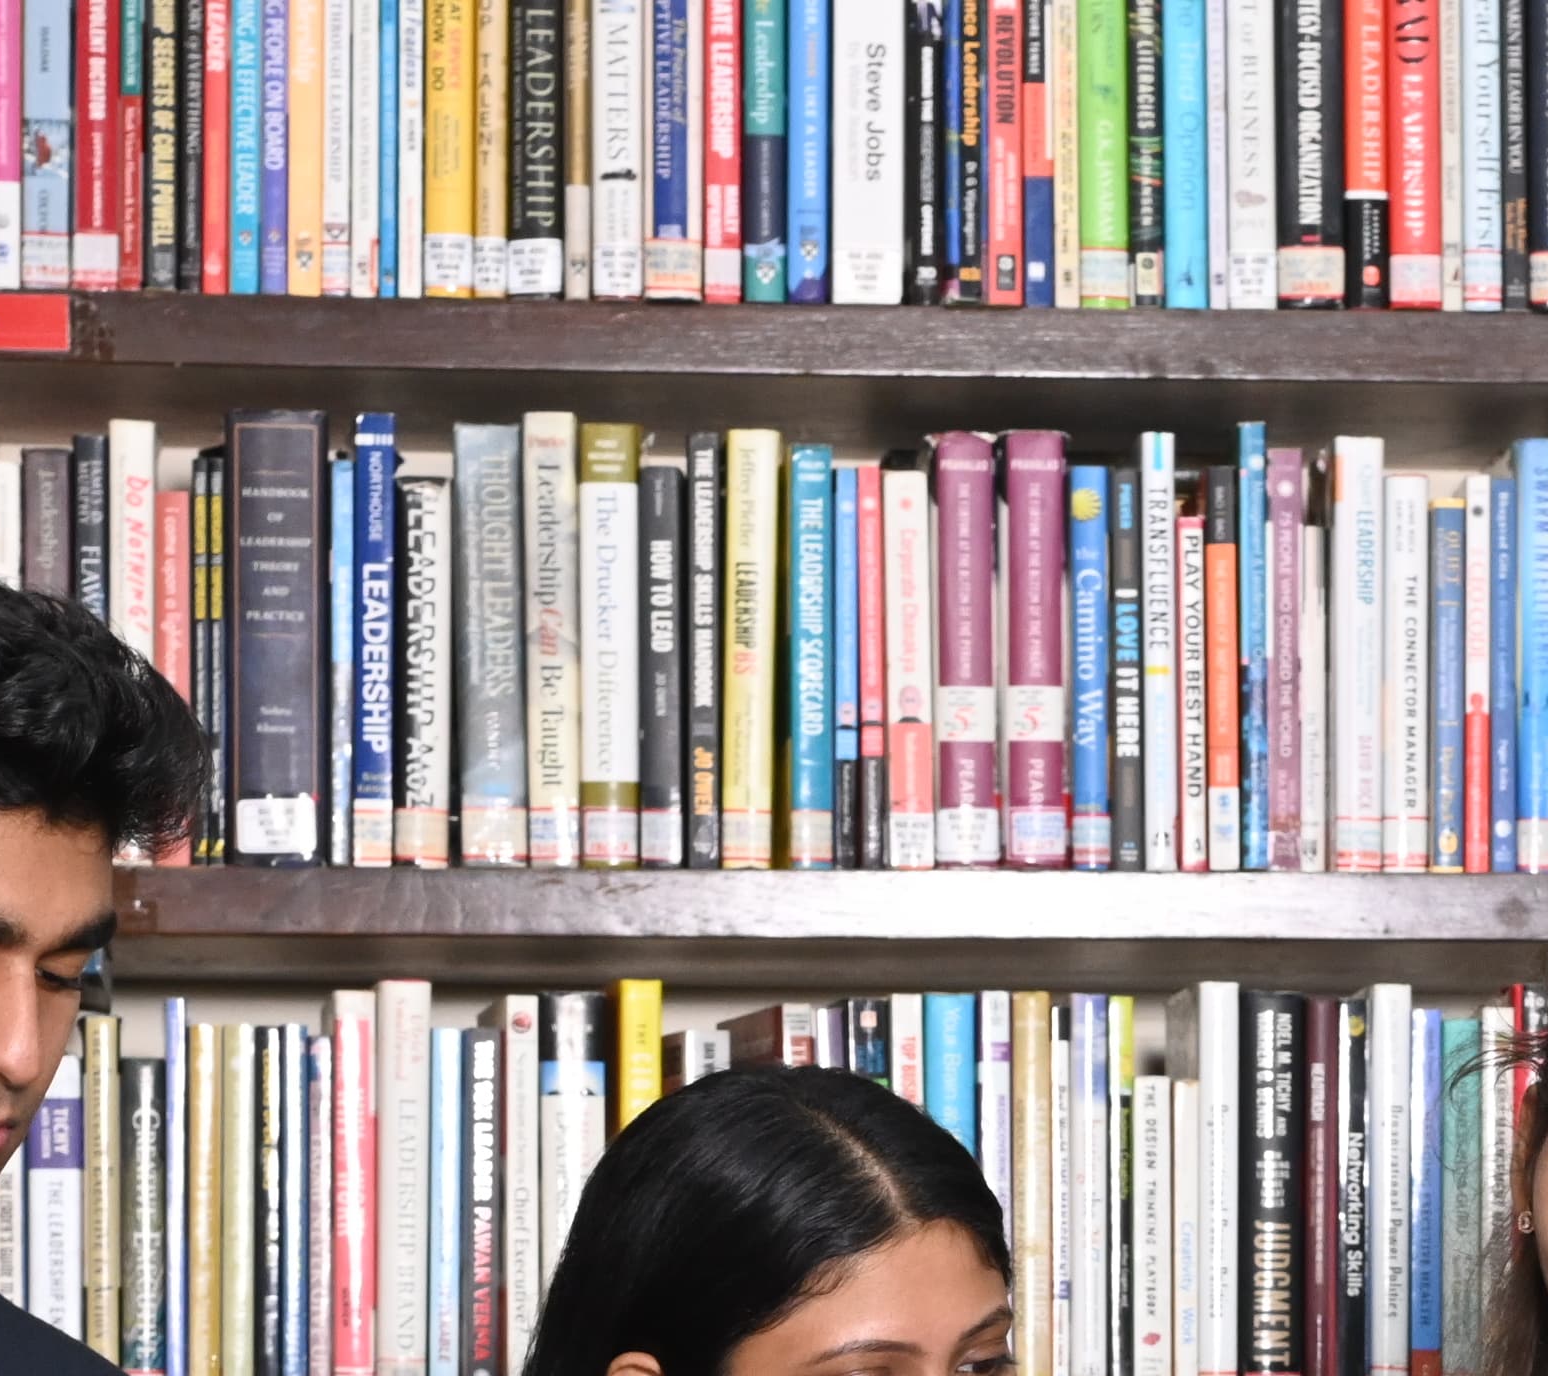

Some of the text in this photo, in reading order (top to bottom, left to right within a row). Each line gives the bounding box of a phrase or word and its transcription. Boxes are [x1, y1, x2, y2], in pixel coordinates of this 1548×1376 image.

[606, 24, 629, 159] MATTERS
[865, 43, 887, 181] Steve Jobs
[996, 15, 1014, 124] REVOLUTION
[362, 451, 390, 753] NORTHOUSE LEADERSHIP
[651, 541, 672, 652] HOW TO LEAD
[799, 499, 823, 735] THE LEADERSHIP SCORECARD
[1116, 605, 1138, 661] LOVE
[1149, 488, 1168, 650] TRANSFLUENCE
[1074, 568, 1102, 750] Camino Way
[1116, 668, 1138, 689] IT
[1116, 697, 1138, 757] HERE
[1184, 536, 1202, 797] PLAY YOUR BEST HAND
[1404, 575, 1417, 809] THE CONNECTOR MANAGER
[473, 1207, 492, 1360] PAWAN VERMA
[1345, 1133, 1364, 1296] Networking Skills
[1254, 1221, 1290, 1366] JUDGMENT
